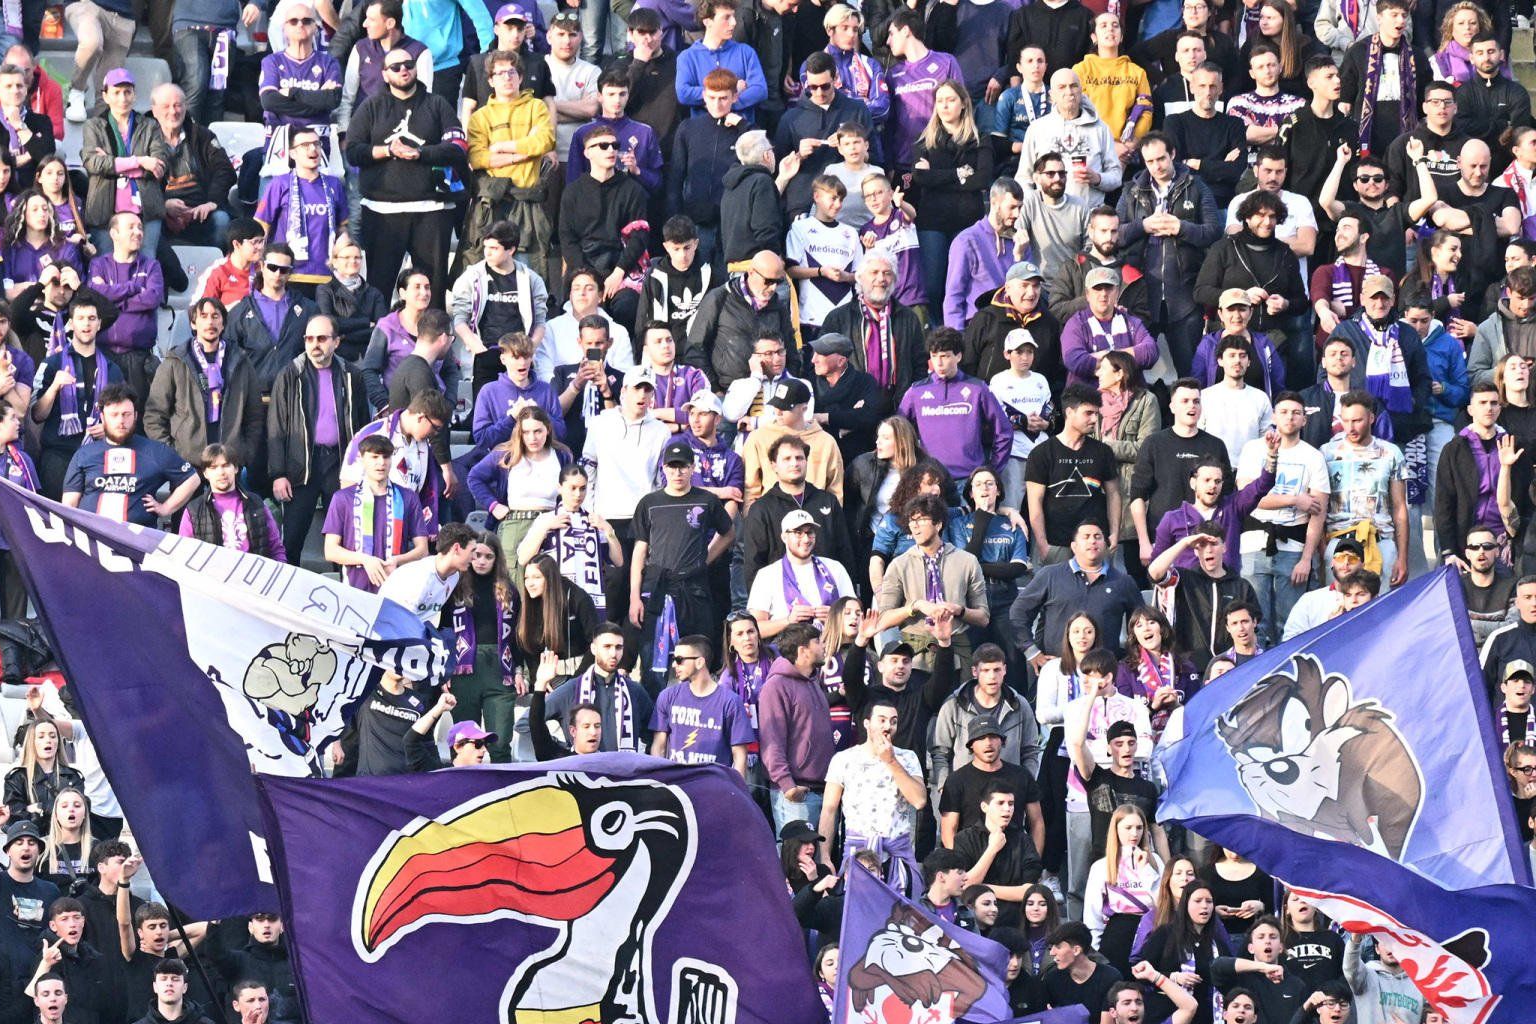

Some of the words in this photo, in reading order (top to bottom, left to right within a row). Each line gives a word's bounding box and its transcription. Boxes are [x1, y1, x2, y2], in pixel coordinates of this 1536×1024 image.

[487, 291, 519, 303] ediaco
[921, 404, 971, 416] Mediacom
[95, 476, 137, 489] QATAR
[370, 700, 421, 722] Mediacom
[1286, 944, 1332, 961] NIKE
